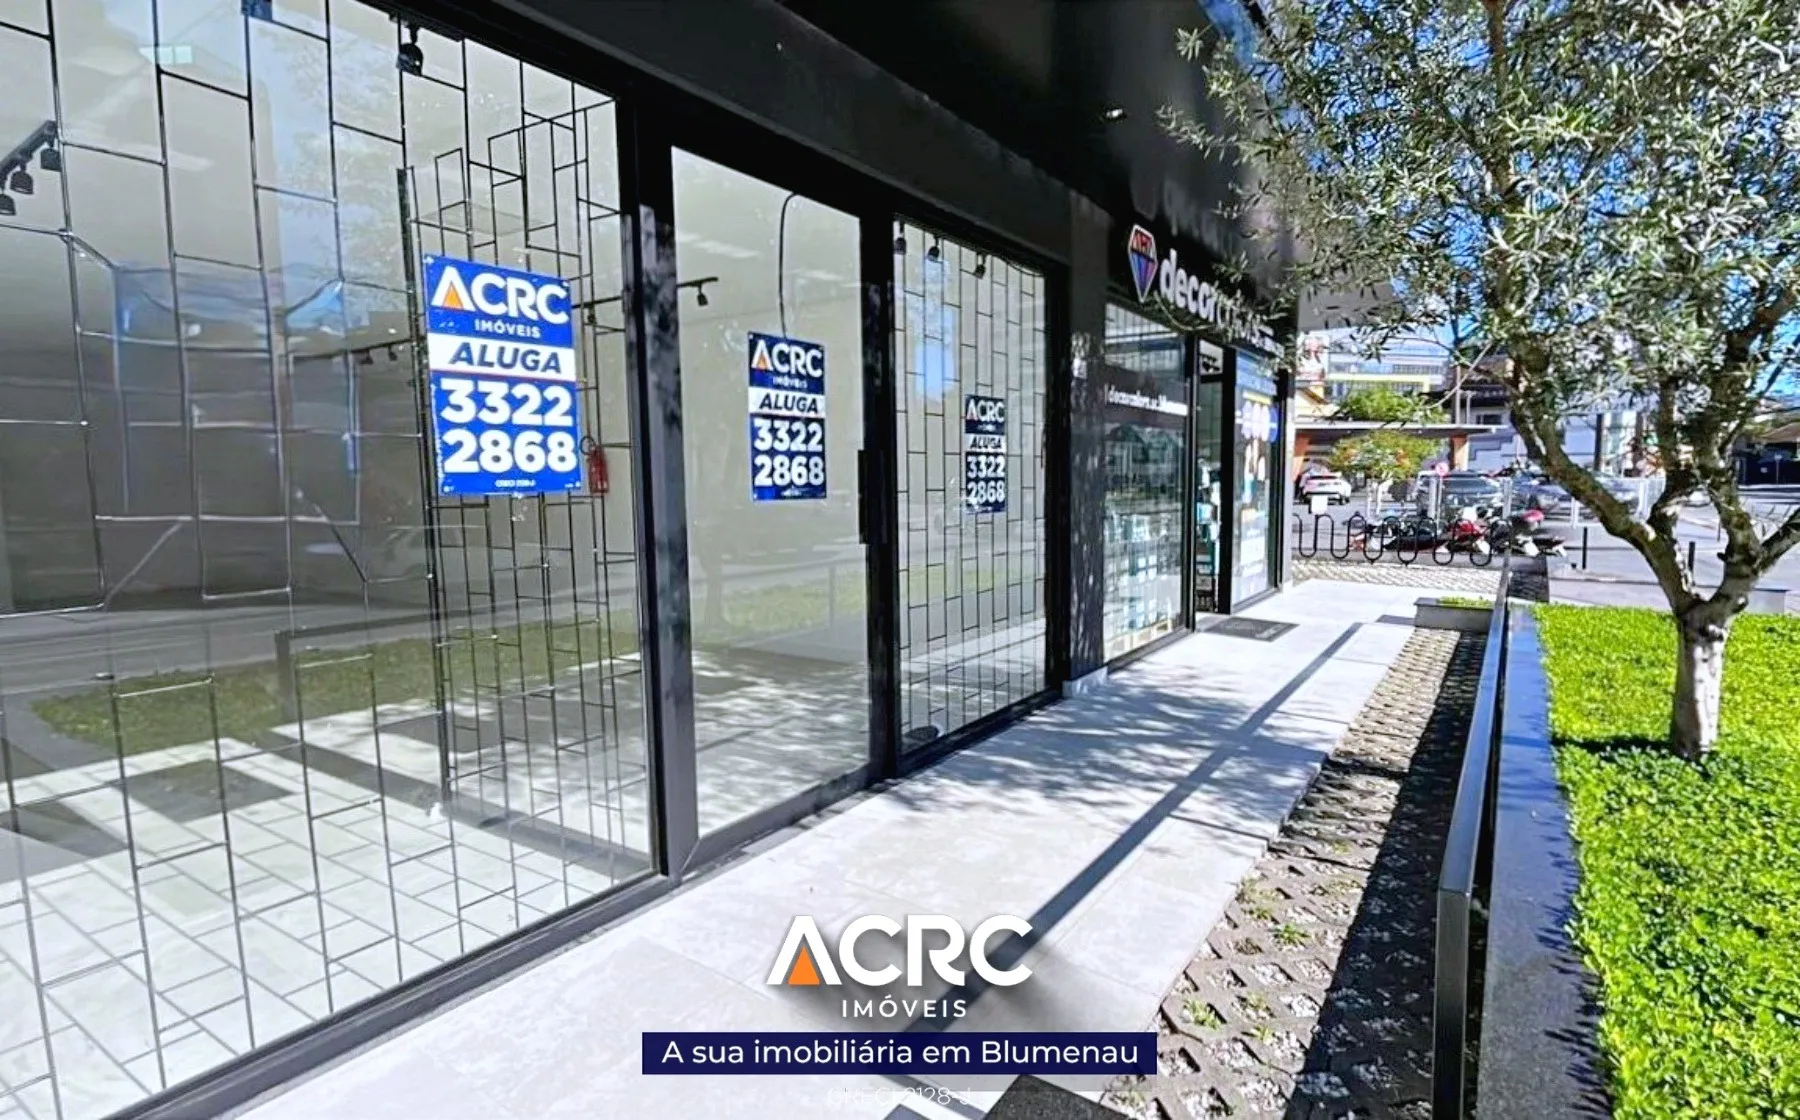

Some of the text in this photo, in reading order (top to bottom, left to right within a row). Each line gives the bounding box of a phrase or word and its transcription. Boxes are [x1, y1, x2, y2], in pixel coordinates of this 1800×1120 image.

[431, 266, 569, 324] ACRC
[475, 318, 541, 339] IMÓVEIS
[449, 342, 562, 374] ALUGA
[751, 339, 823, 378] ACRC
[440, 378, 573, 426] 3322
[759, 392, 819, 414] ALUGA
[966, 399, 1004, 423] ACRC
[441, 428, 577, 473] 2868
[753, 418, 823, 452] 3322
[970, 435, 1002, 449] ALUGA
[754, 454, 824, 486] 2868
[967, 455, 1005, 479] 3322
[967, 480, 1005, 504] 2868
